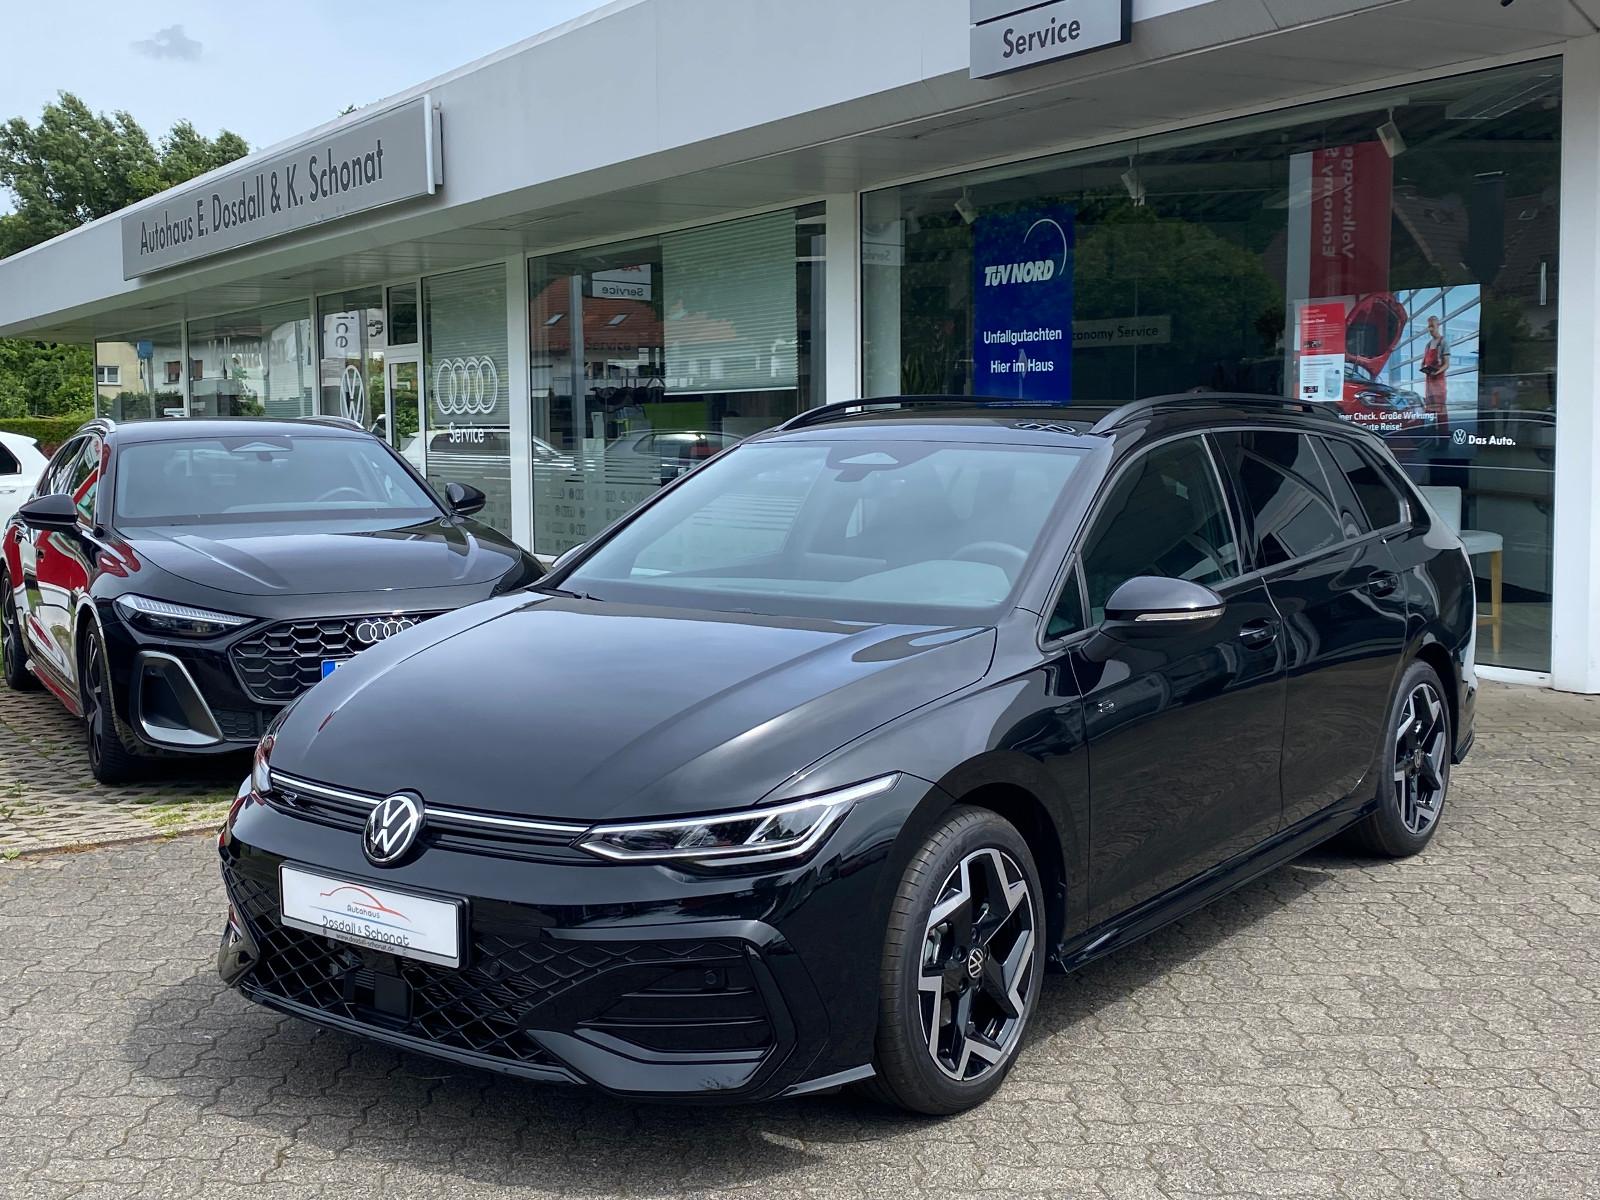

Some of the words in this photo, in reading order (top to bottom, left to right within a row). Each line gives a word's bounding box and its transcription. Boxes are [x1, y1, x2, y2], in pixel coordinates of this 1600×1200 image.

[1002, 17, 1081, 58] Service
[140, 211, 194, 255] Autohaus
[196, 199, 209, 237] E.
[212, 174, 265, 233] Dosdall
[270, 171, 281, 214] &
[286, 163, 304, 208] K.
[309, 139, 384, 202] Schonat
[984, 264, 1012, 287] TÜV
[1011, 259, 1054, 283] NORD
[984, 327, 1062, 346] Unfallgutachten
[1117, 325, 1159, 338] Service
[990, 360, 1011, 373] Hier
[1012, 359, 1025, 373] im
[1027, 359, 1054, 372] Haus
[1354, 412, 1378, 421] Check.
[1379, 411, 1402, 420] Große
[449, 422, 485, 444] Service
[1380, 423, 1402, 431] Reise!
[1468, 434, 1488, 445] Das
[1490, 435, 1516, 446] Auto.
[347, 904, 381, 919] Autohaus
[322, 915, 356, 935] Dosdall
[357, 925, 362, 934] &
[364, 925, 410, 946] Schonat
